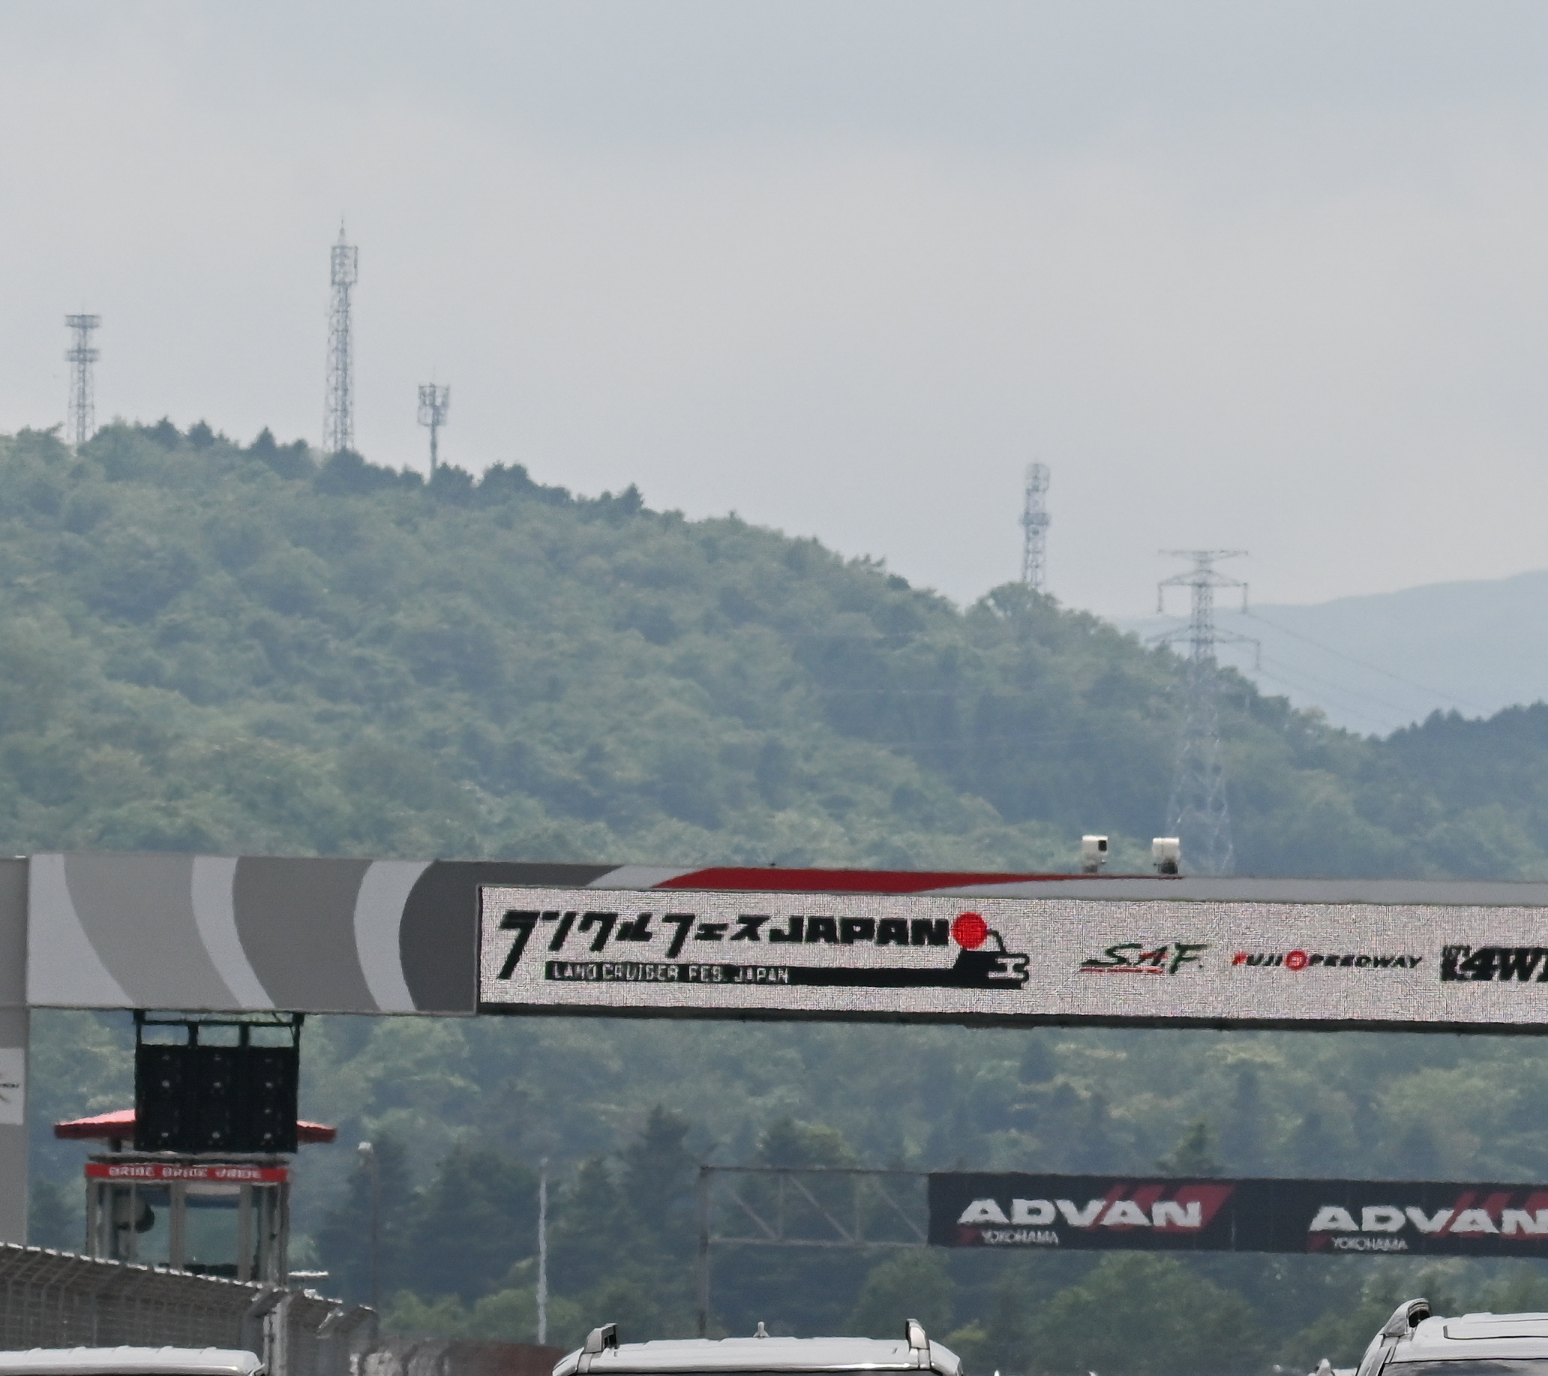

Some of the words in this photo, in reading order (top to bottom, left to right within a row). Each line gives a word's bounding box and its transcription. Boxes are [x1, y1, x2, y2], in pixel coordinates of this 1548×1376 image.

[957, 1198, 1203, 1227] ADVAN
[981, 1229, 1059, 1245] YOKOHAMA
[1331, 1236, 1409, 1252] YOKOHAMA
